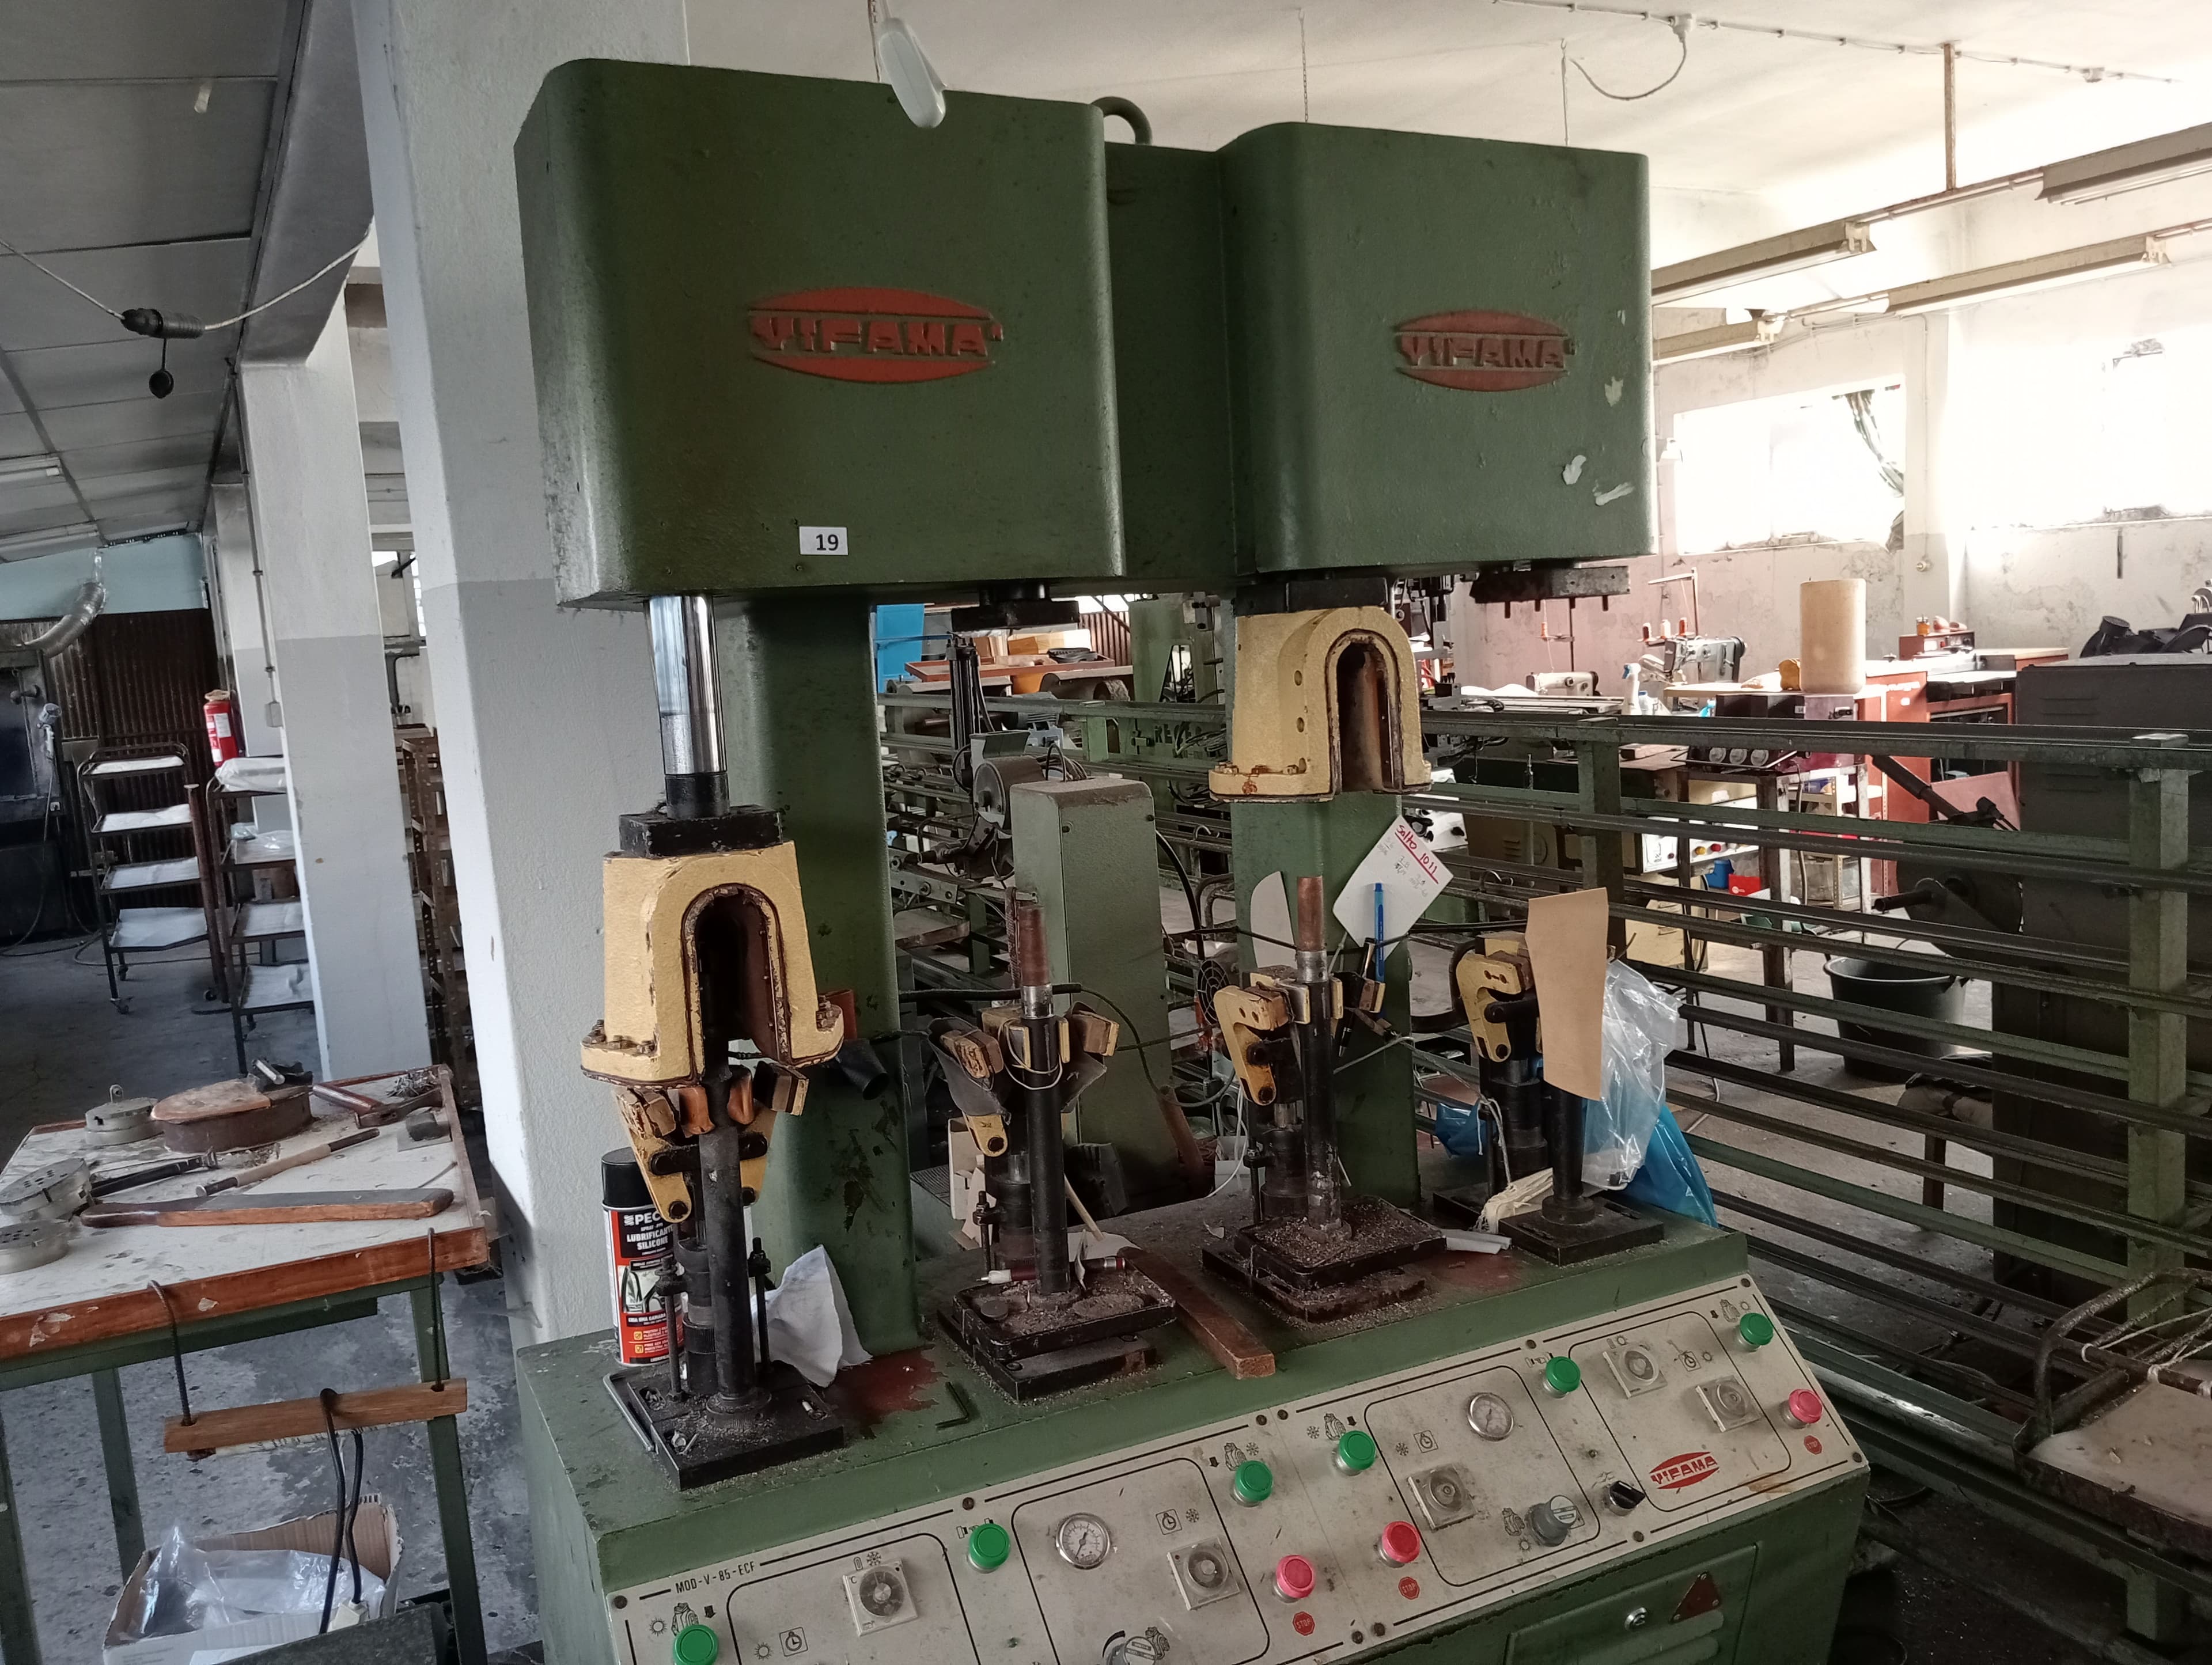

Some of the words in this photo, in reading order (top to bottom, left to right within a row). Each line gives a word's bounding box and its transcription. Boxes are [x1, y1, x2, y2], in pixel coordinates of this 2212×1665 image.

[815, 534, 839, 551] 19
[637, 1236, 668, 1250] SILICONE
[1650, 1456, 1718, 1485] VIFAMA
[1402, 1583, 1416, 1594] STOP
[1296, 1619, 1312, 1629] STOP
